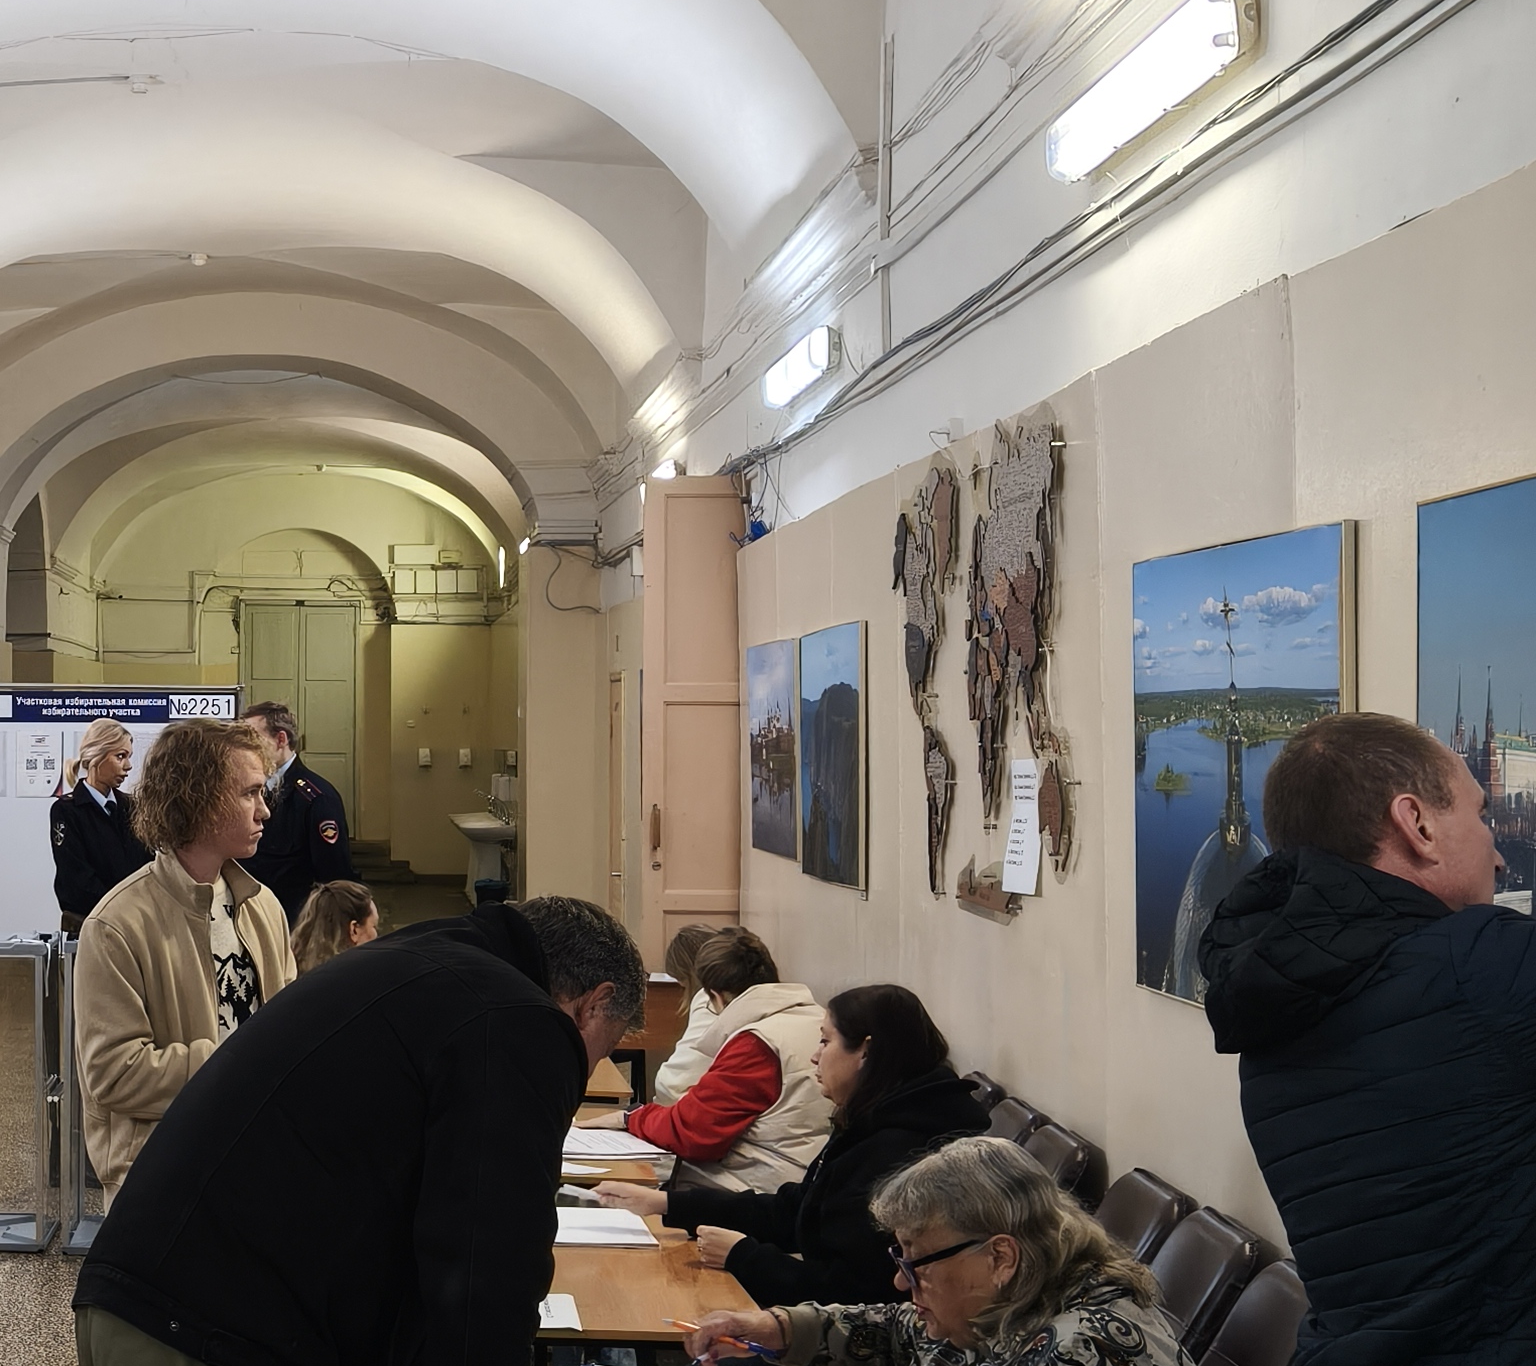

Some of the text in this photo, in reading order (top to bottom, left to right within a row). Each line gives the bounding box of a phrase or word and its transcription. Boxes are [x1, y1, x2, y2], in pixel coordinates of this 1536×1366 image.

[16, 697, 167, 707] Участковая избирательная комиссия
[169, 698, 231, 716] №2251
[42, 707, 141, 717] избирательного участка
